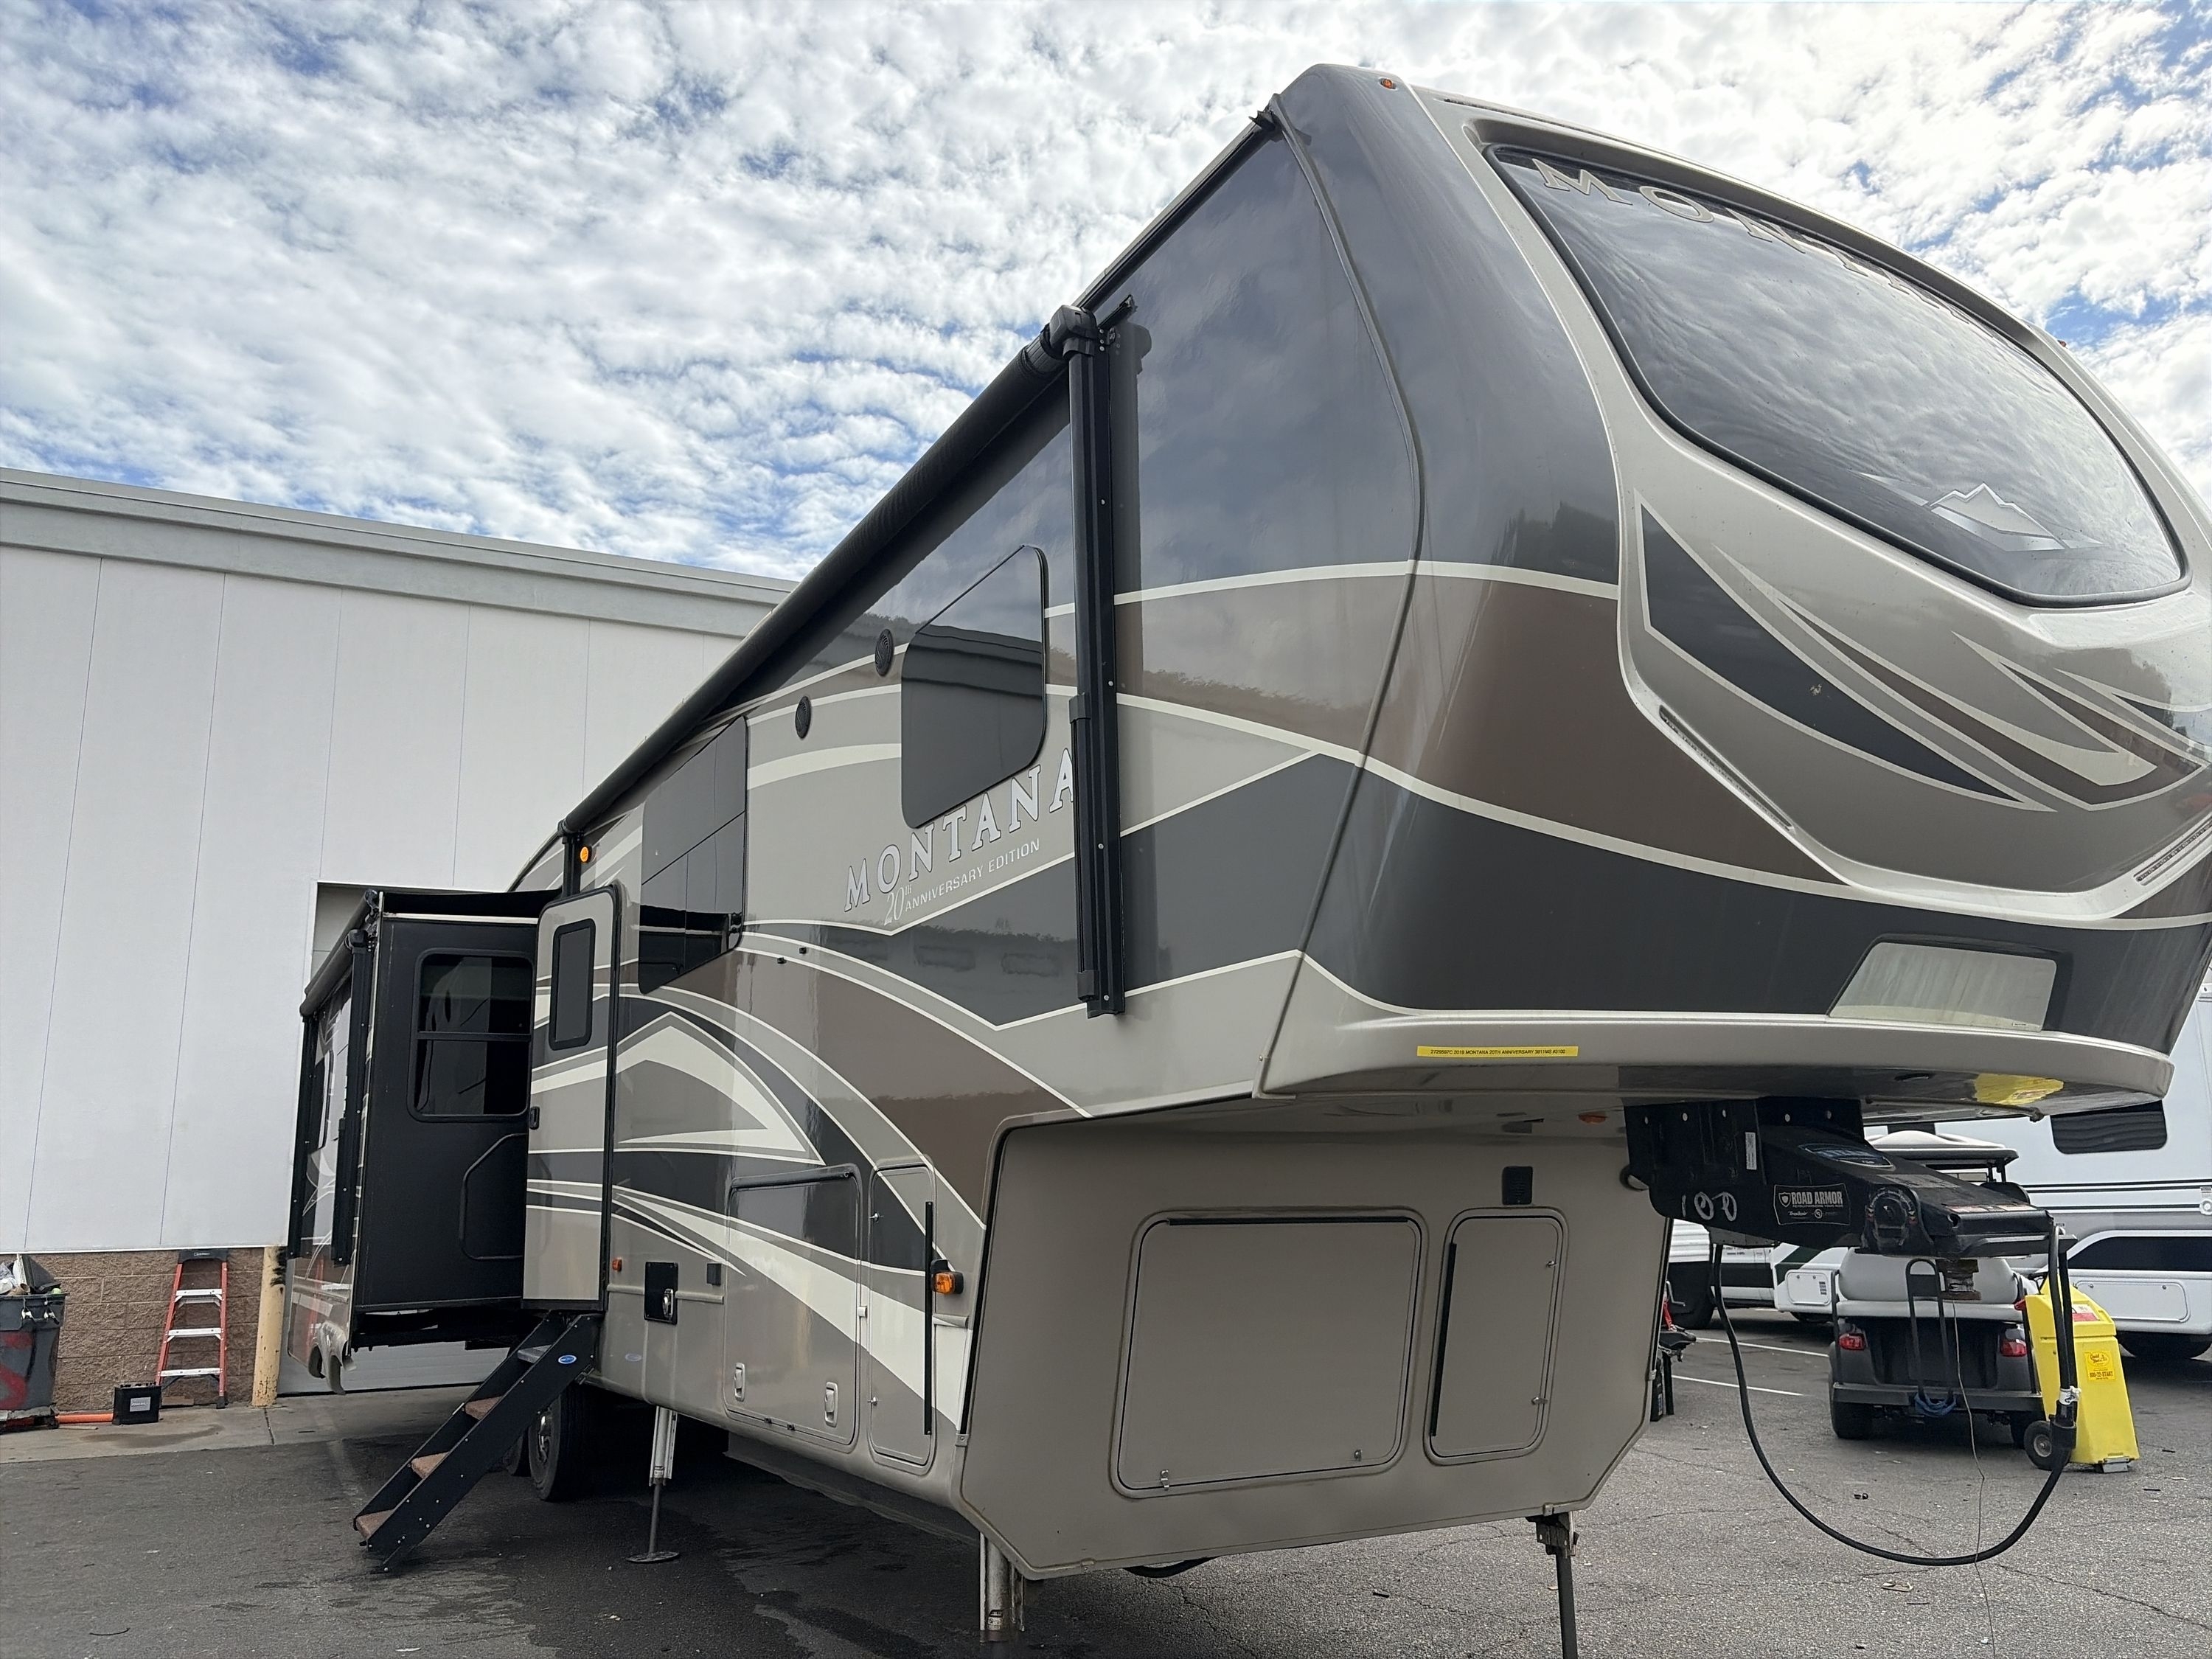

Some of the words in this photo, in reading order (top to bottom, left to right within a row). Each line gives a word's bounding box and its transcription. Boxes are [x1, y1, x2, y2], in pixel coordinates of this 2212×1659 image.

[1531, 157, 1994, 338] MONT
[844, 748, 1074, 913] MONTANA
[905, 865, 984, 913] ANNIVERSARY
[988, 838, 1040, 873] EDITION
[1791, 1192, 1813, 1205] ROAD
[1814, 1191, 1843, 1205] ARMOR
